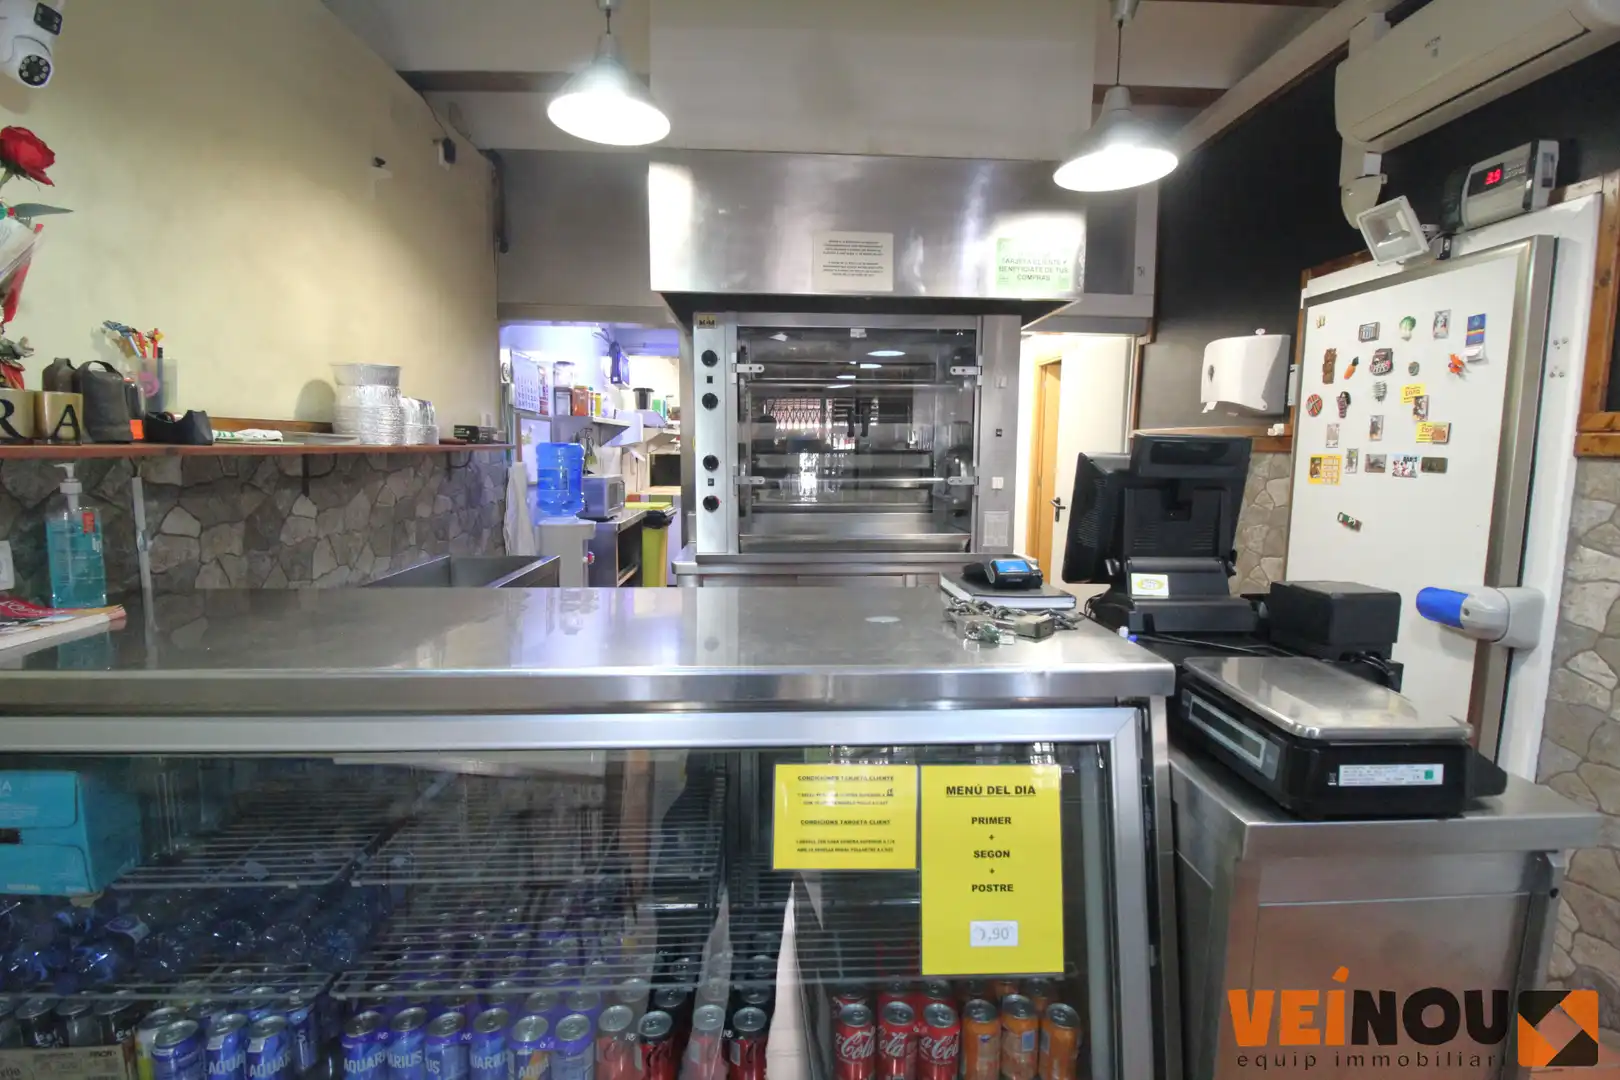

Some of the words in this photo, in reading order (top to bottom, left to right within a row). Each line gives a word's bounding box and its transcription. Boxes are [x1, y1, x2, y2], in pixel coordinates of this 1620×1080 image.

[1017, 273, 1051, 281] COMPRAS
[986, 785, 1011, 796] DEL
[971, 816, 1012, 825] PRIMER
[973, 850, 1011, 859] SEGON
[971, 884, 1014, 893] POSTRE
